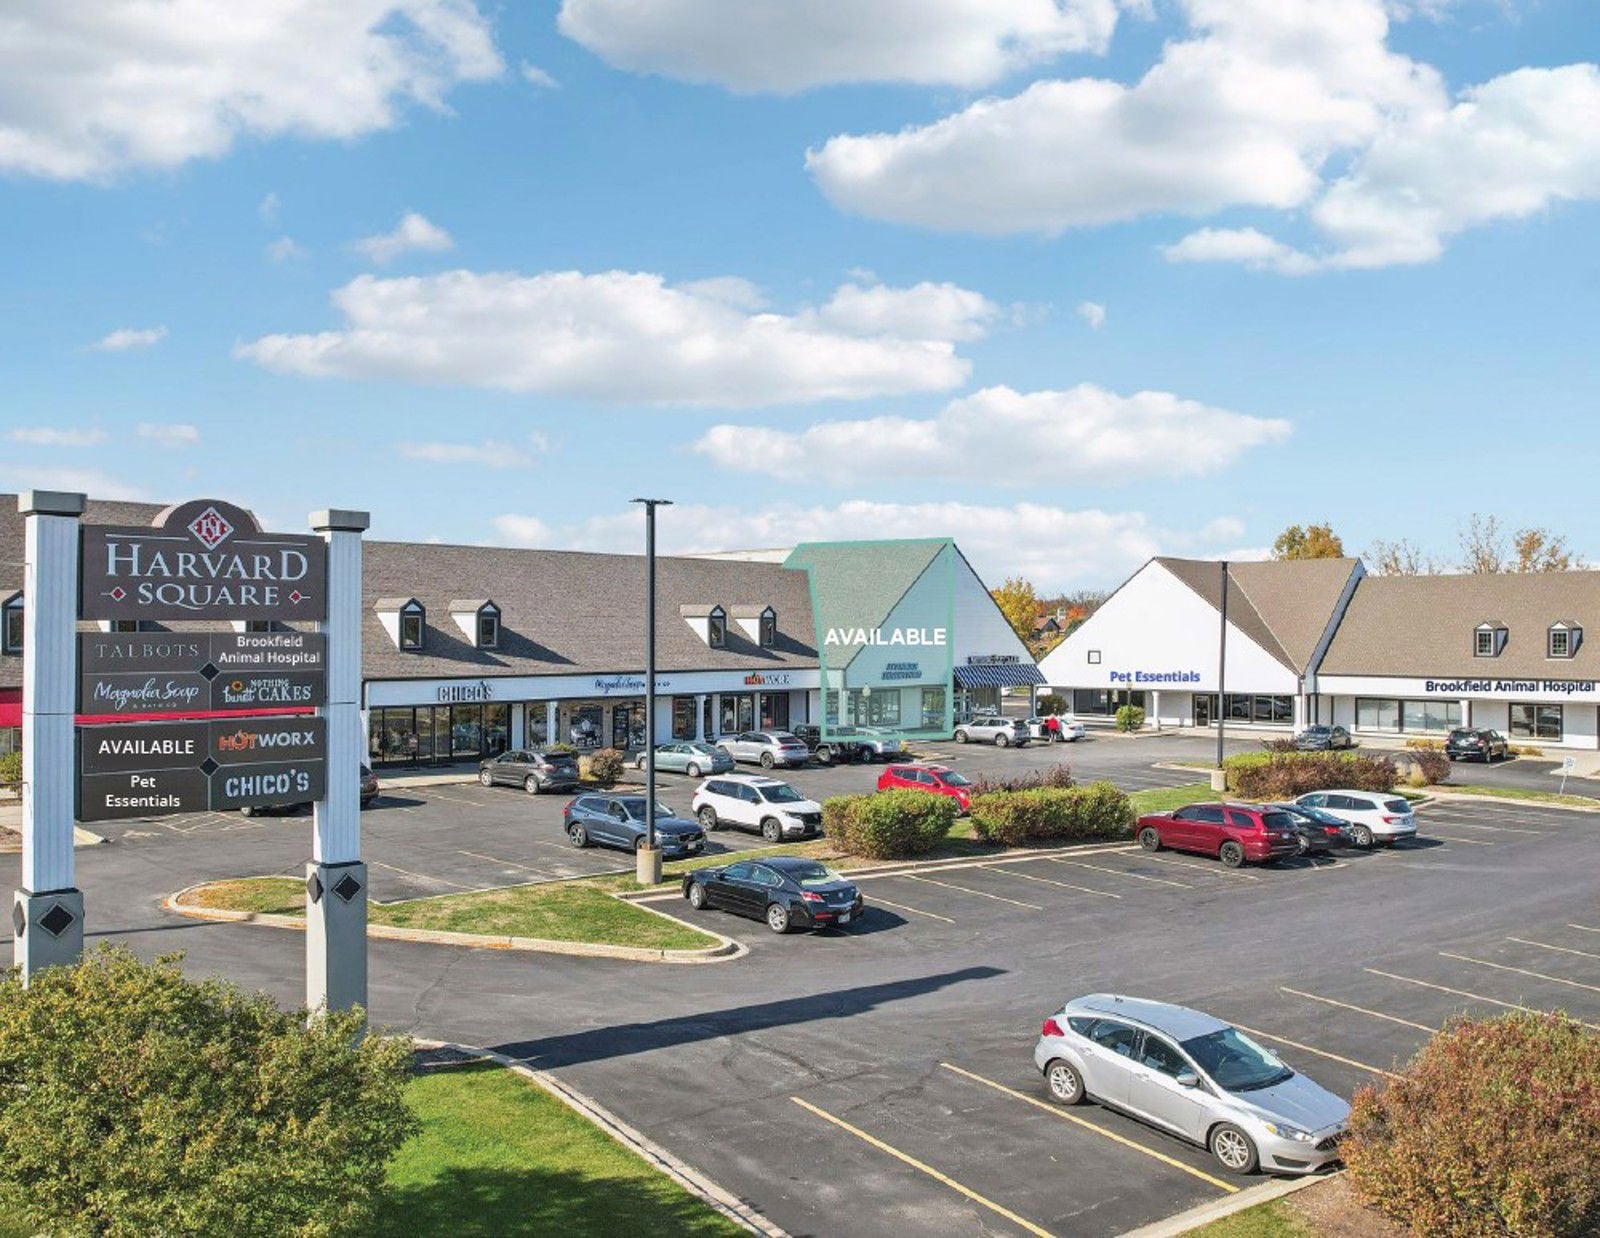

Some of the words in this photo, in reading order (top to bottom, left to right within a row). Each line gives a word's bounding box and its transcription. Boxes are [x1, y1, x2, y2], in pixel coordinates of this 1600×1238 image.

[105, 542, 308, 581] HARVARD
[137, 583, 280, 610] SQUARE
[236, 635, 304, 648] Brookfield
[95, 643, 200, 659] TALBOTS
[218, 651, 265, 664] Animal
[267, 651, 321, 666] Hospital
[250, 679, 290, 689] NOTHING
[1109, 671, 1132, 682] Pet
[1135, 670, 1201, 682] Essentials
[94, 677, 161, 711] Magnolia
[258, 685, 312, 702] CAKES
[1425, 680, 1492, 692] Brookfield
[1494, 680, 1539, 692] Animal
[1542, 680, 1596, 695] Hospital
[98, 739, 195, 755] AVAILABLE
[218, 729, 315, 751] HOTWORX
[130, 775, 156, 788] Pet
[225, 768, 310, 799] CHICO'S
[105, 793, 181, 808] Essentials
